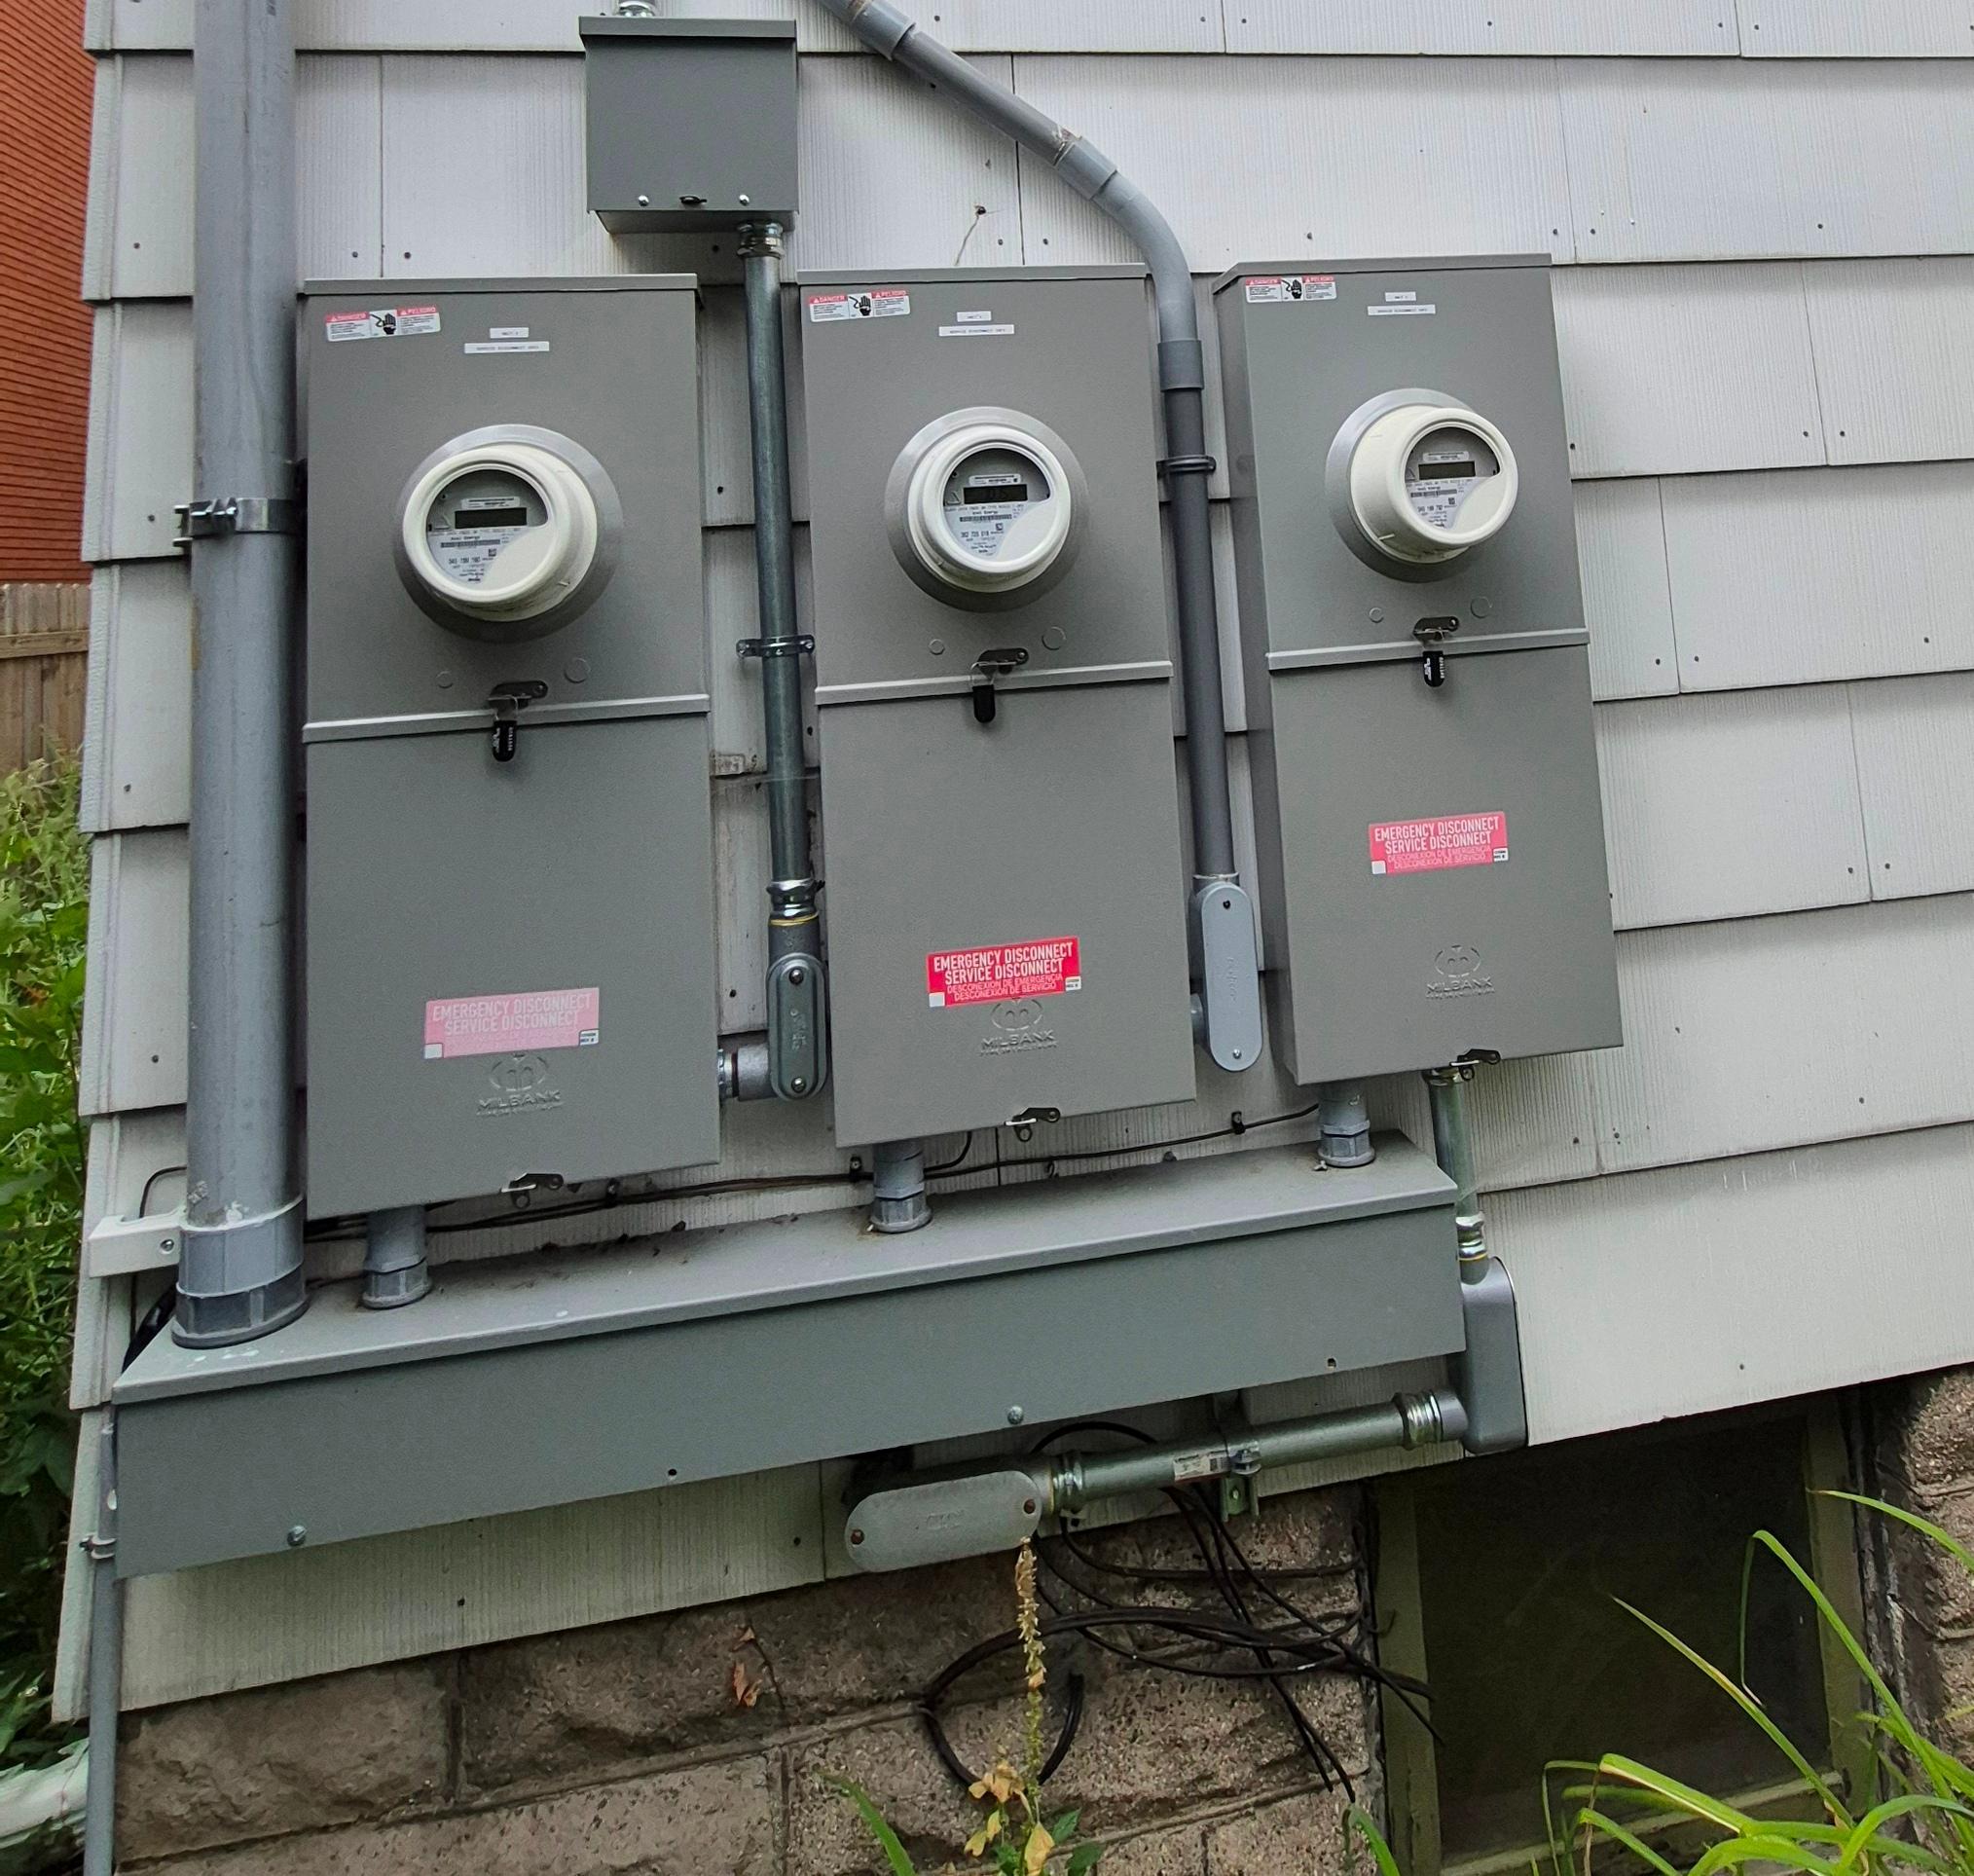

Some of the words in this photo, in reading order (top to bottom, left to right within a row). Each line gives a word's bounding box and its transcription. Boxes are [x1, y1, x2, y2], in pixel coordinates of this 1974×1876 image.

[1374, 822, 1435, 842] EMERGENCY
[1438, 816, 1500, 834] DISCONNECT
[1384, 836, 1427, 855] SERVICE
[1430, 830, 1492, 850] DISCONNECT
[933, 949, 1002, 973] EMERGENCY
[1005, 941, 1073, 962] DISCONNECT
[945, 965, 993, 985] SERVICE
[995, 957, 1064, 978] DISCONNECT
[1003, 978, 1013, 987] DE
[1009, 985, 1020, 994] DE
[432, 1001, 510, 1022] EMERGENCY
[513, 992, 593, 1014] DISCONNECT
[444, 1016, 498, 1037] SERVICE
[501, 1011, 579, 1031] DISCONNECT
